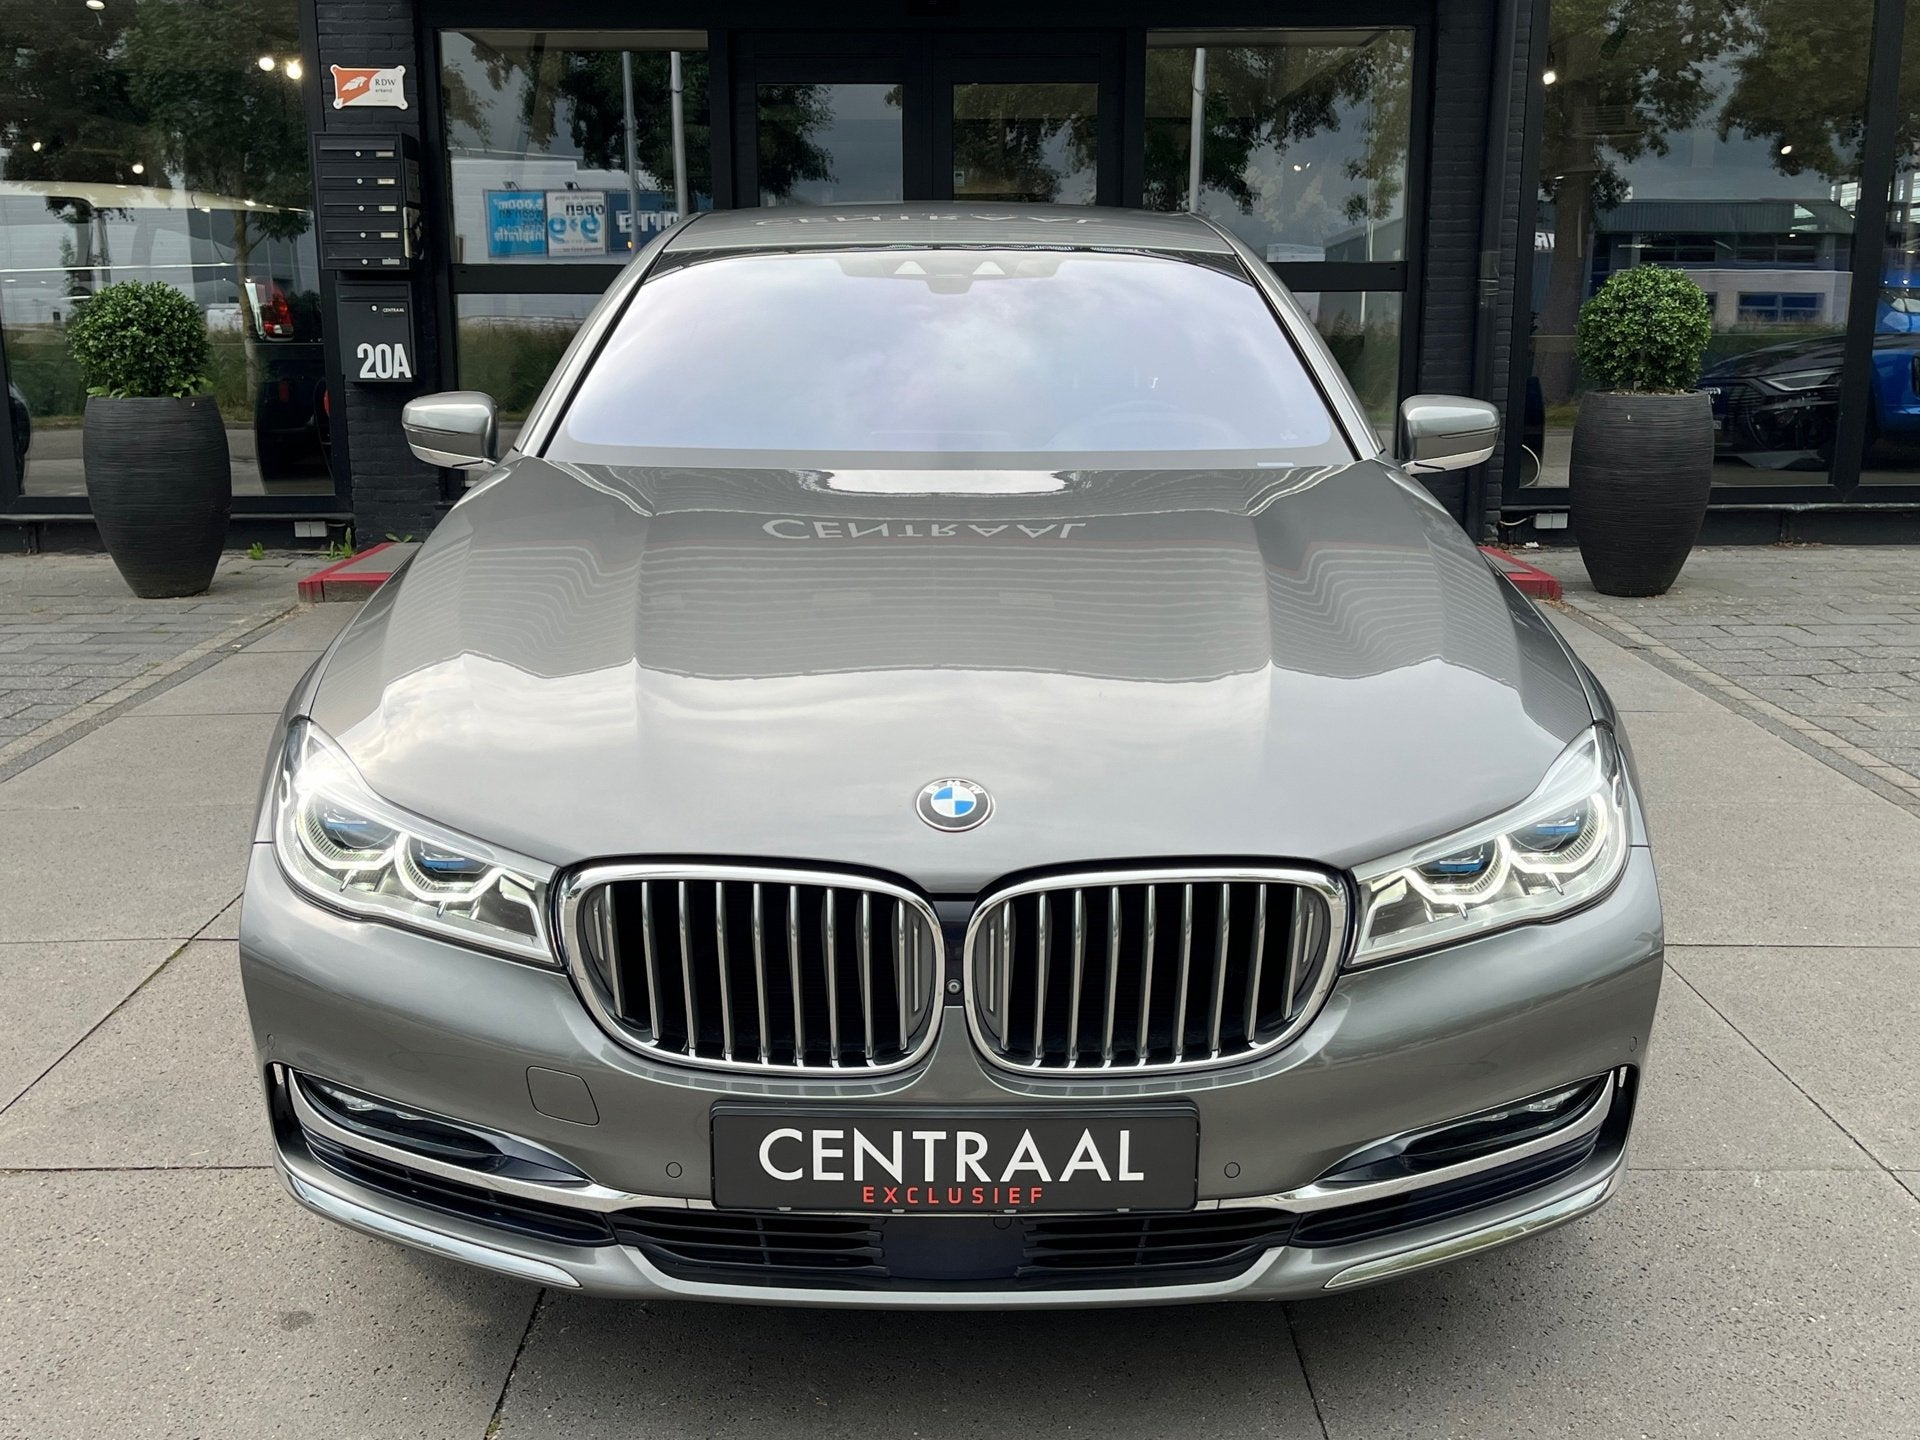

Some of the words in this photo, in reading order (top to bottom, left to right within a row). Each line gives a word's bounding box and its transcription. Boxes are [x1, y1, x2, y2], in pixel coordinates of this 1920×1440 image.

[375, 78, 397, 86] RDW
[356, 342, 412, 379] 20A
[758, 1127, 1145, 1184] CENTRAAL
[862, 1186, 1043, 1204] EXCLUSIEF
